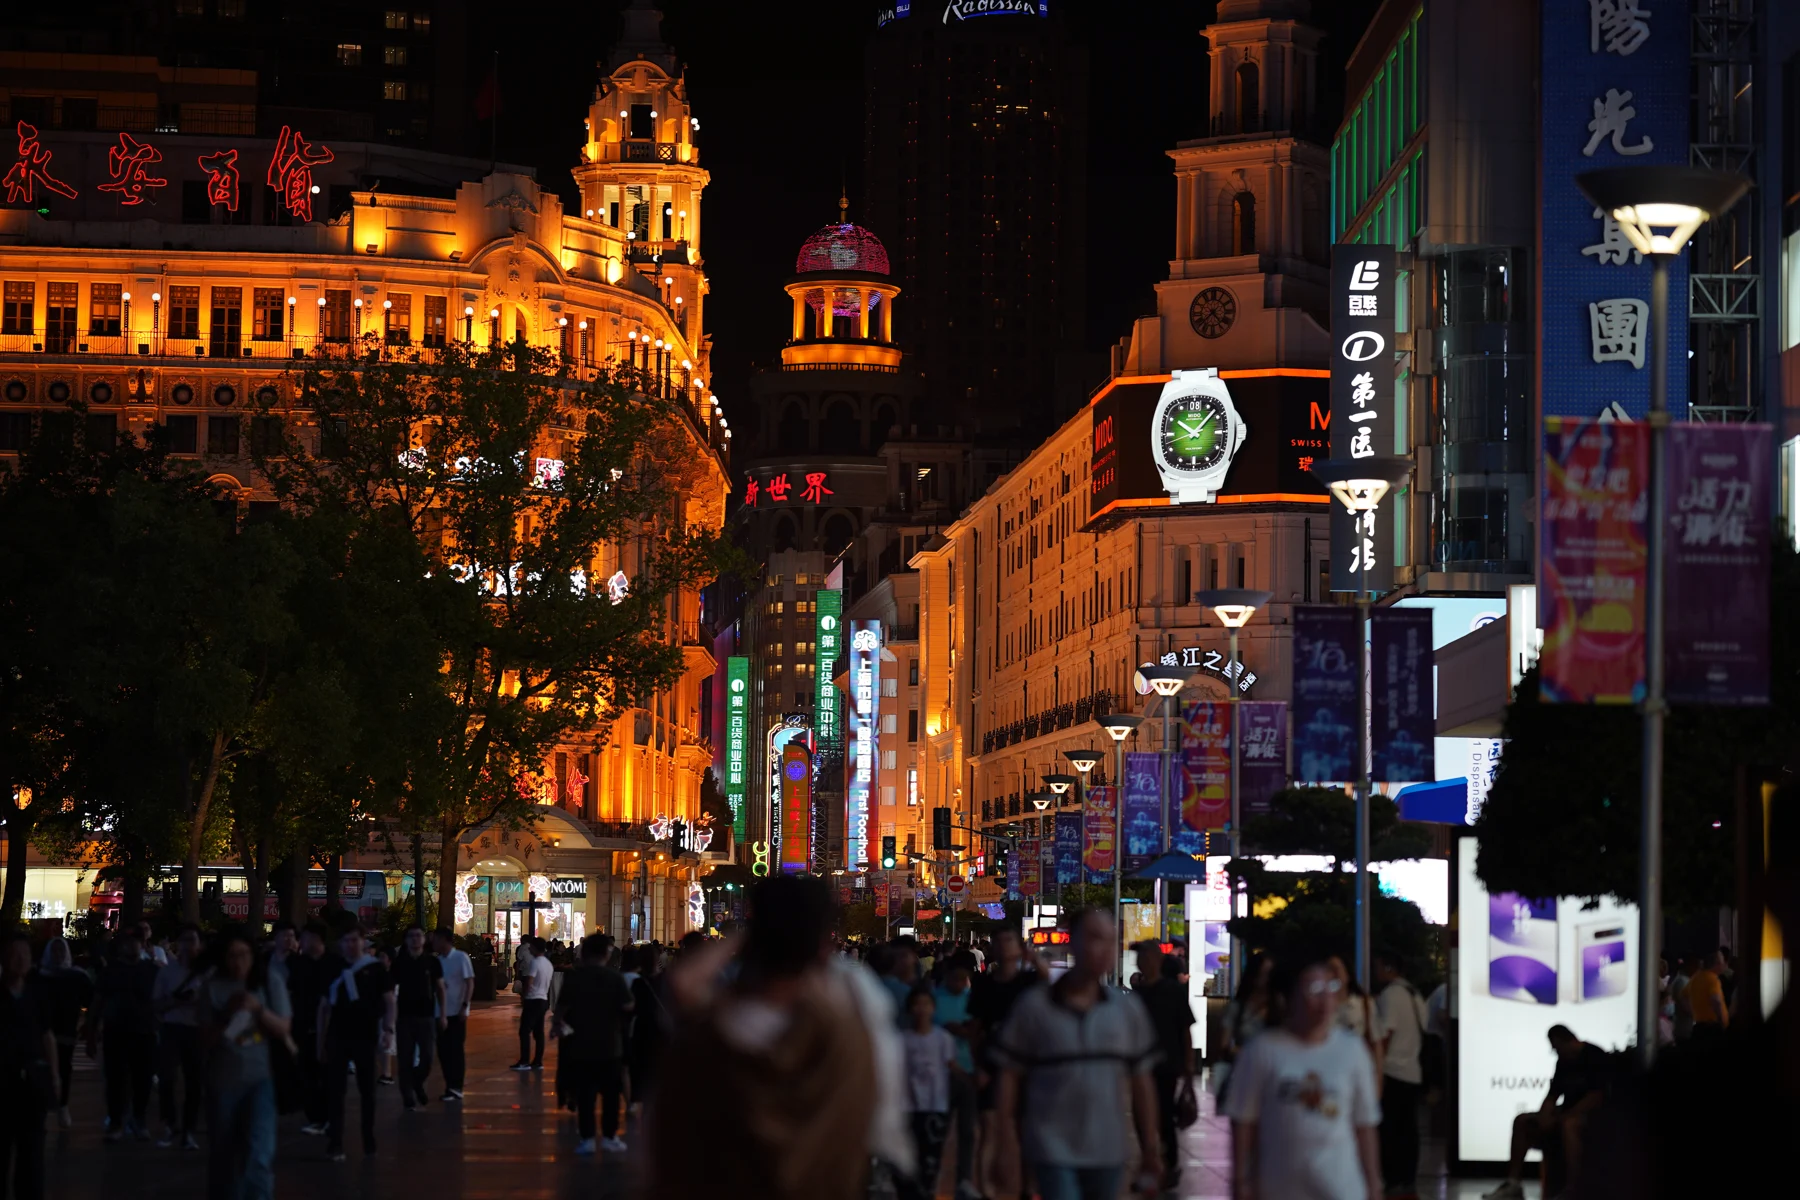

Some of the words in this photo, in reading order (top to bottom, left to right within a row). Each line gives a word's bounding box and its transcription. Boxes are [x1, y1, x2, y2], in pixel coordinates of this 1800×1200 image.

[896, 4, 910, 14] BLU
[943, 0, 1036, 26] Radisson
[1348, 295, 1378, 309] 百联
[1189, 401, 1200, 411] 08
[1290, 438, 1322, 447] SWISS
[745, 472, 835, 508] 新世界
[1160, 647, 1245, 681] 锦江之星
[820, 634, 836, 738] 第一百货商业中心
[730, 695, 743, 784] 第一百货商业中心
[858, 790, 870, 812] First
[857, 813, 870, 864] Foodhall
